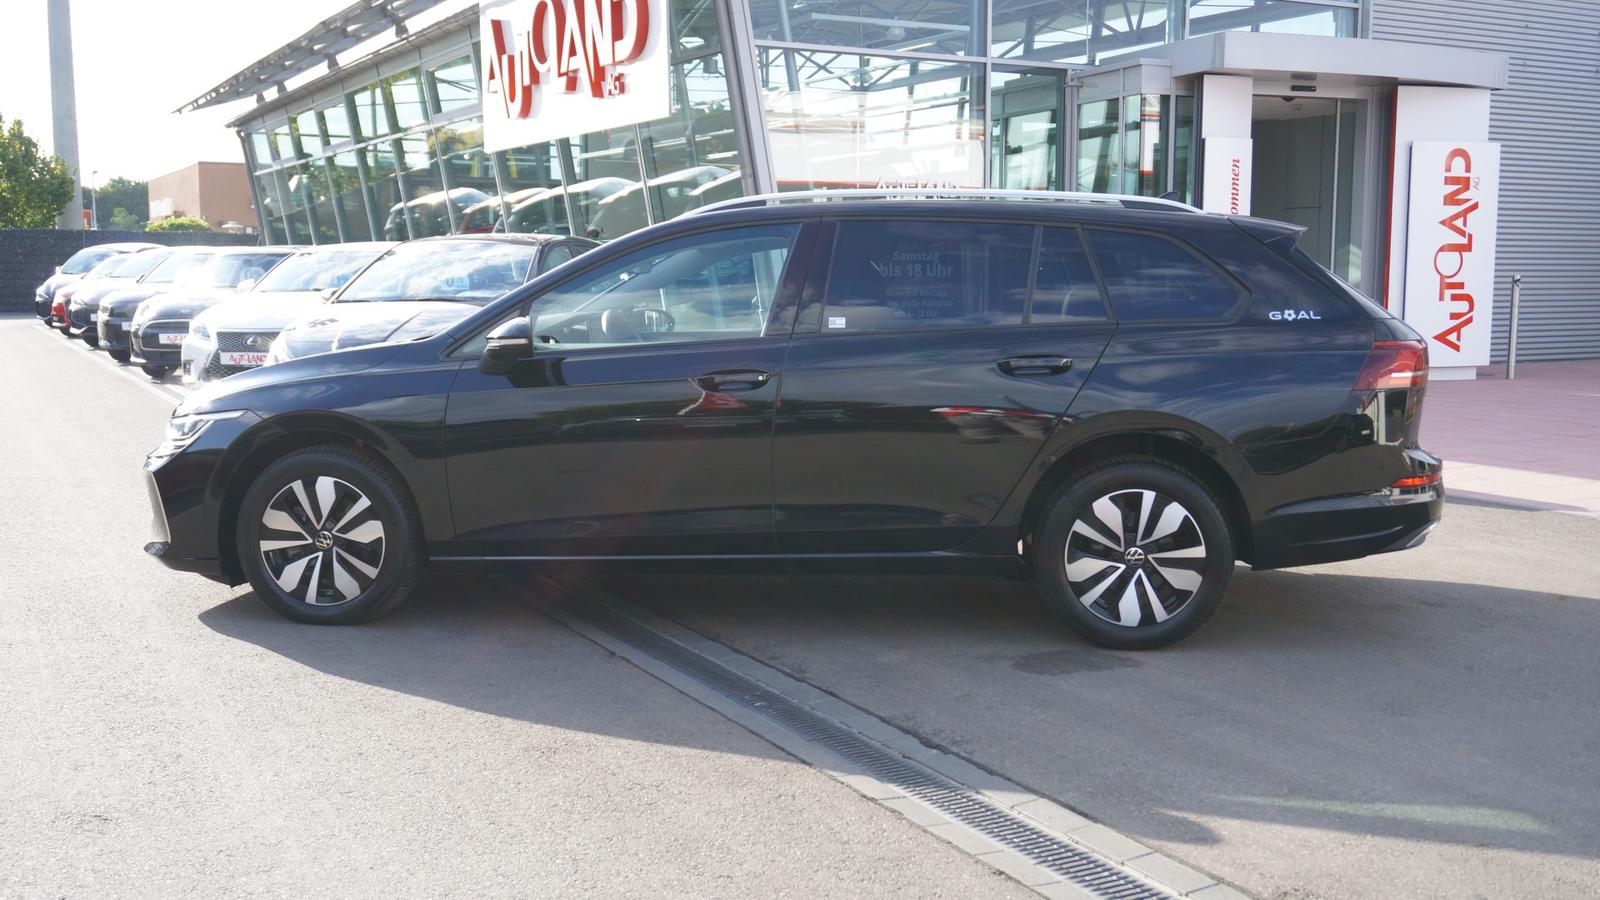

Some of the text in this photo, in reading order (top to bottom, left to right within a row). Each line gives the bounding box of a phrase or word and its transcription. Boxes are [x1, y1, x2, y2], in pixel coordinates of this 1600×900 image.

[606, 73, 625, 98] AG
[1472, 176, 1481, 191] AG
[893, 250, 940, 264] Samstag
[1432, 147, 1479, 353] AUTOLAND
[880, 262, 954, 278] bis 18 Uhr
[1268, 309, 1322, 322] GOAL
